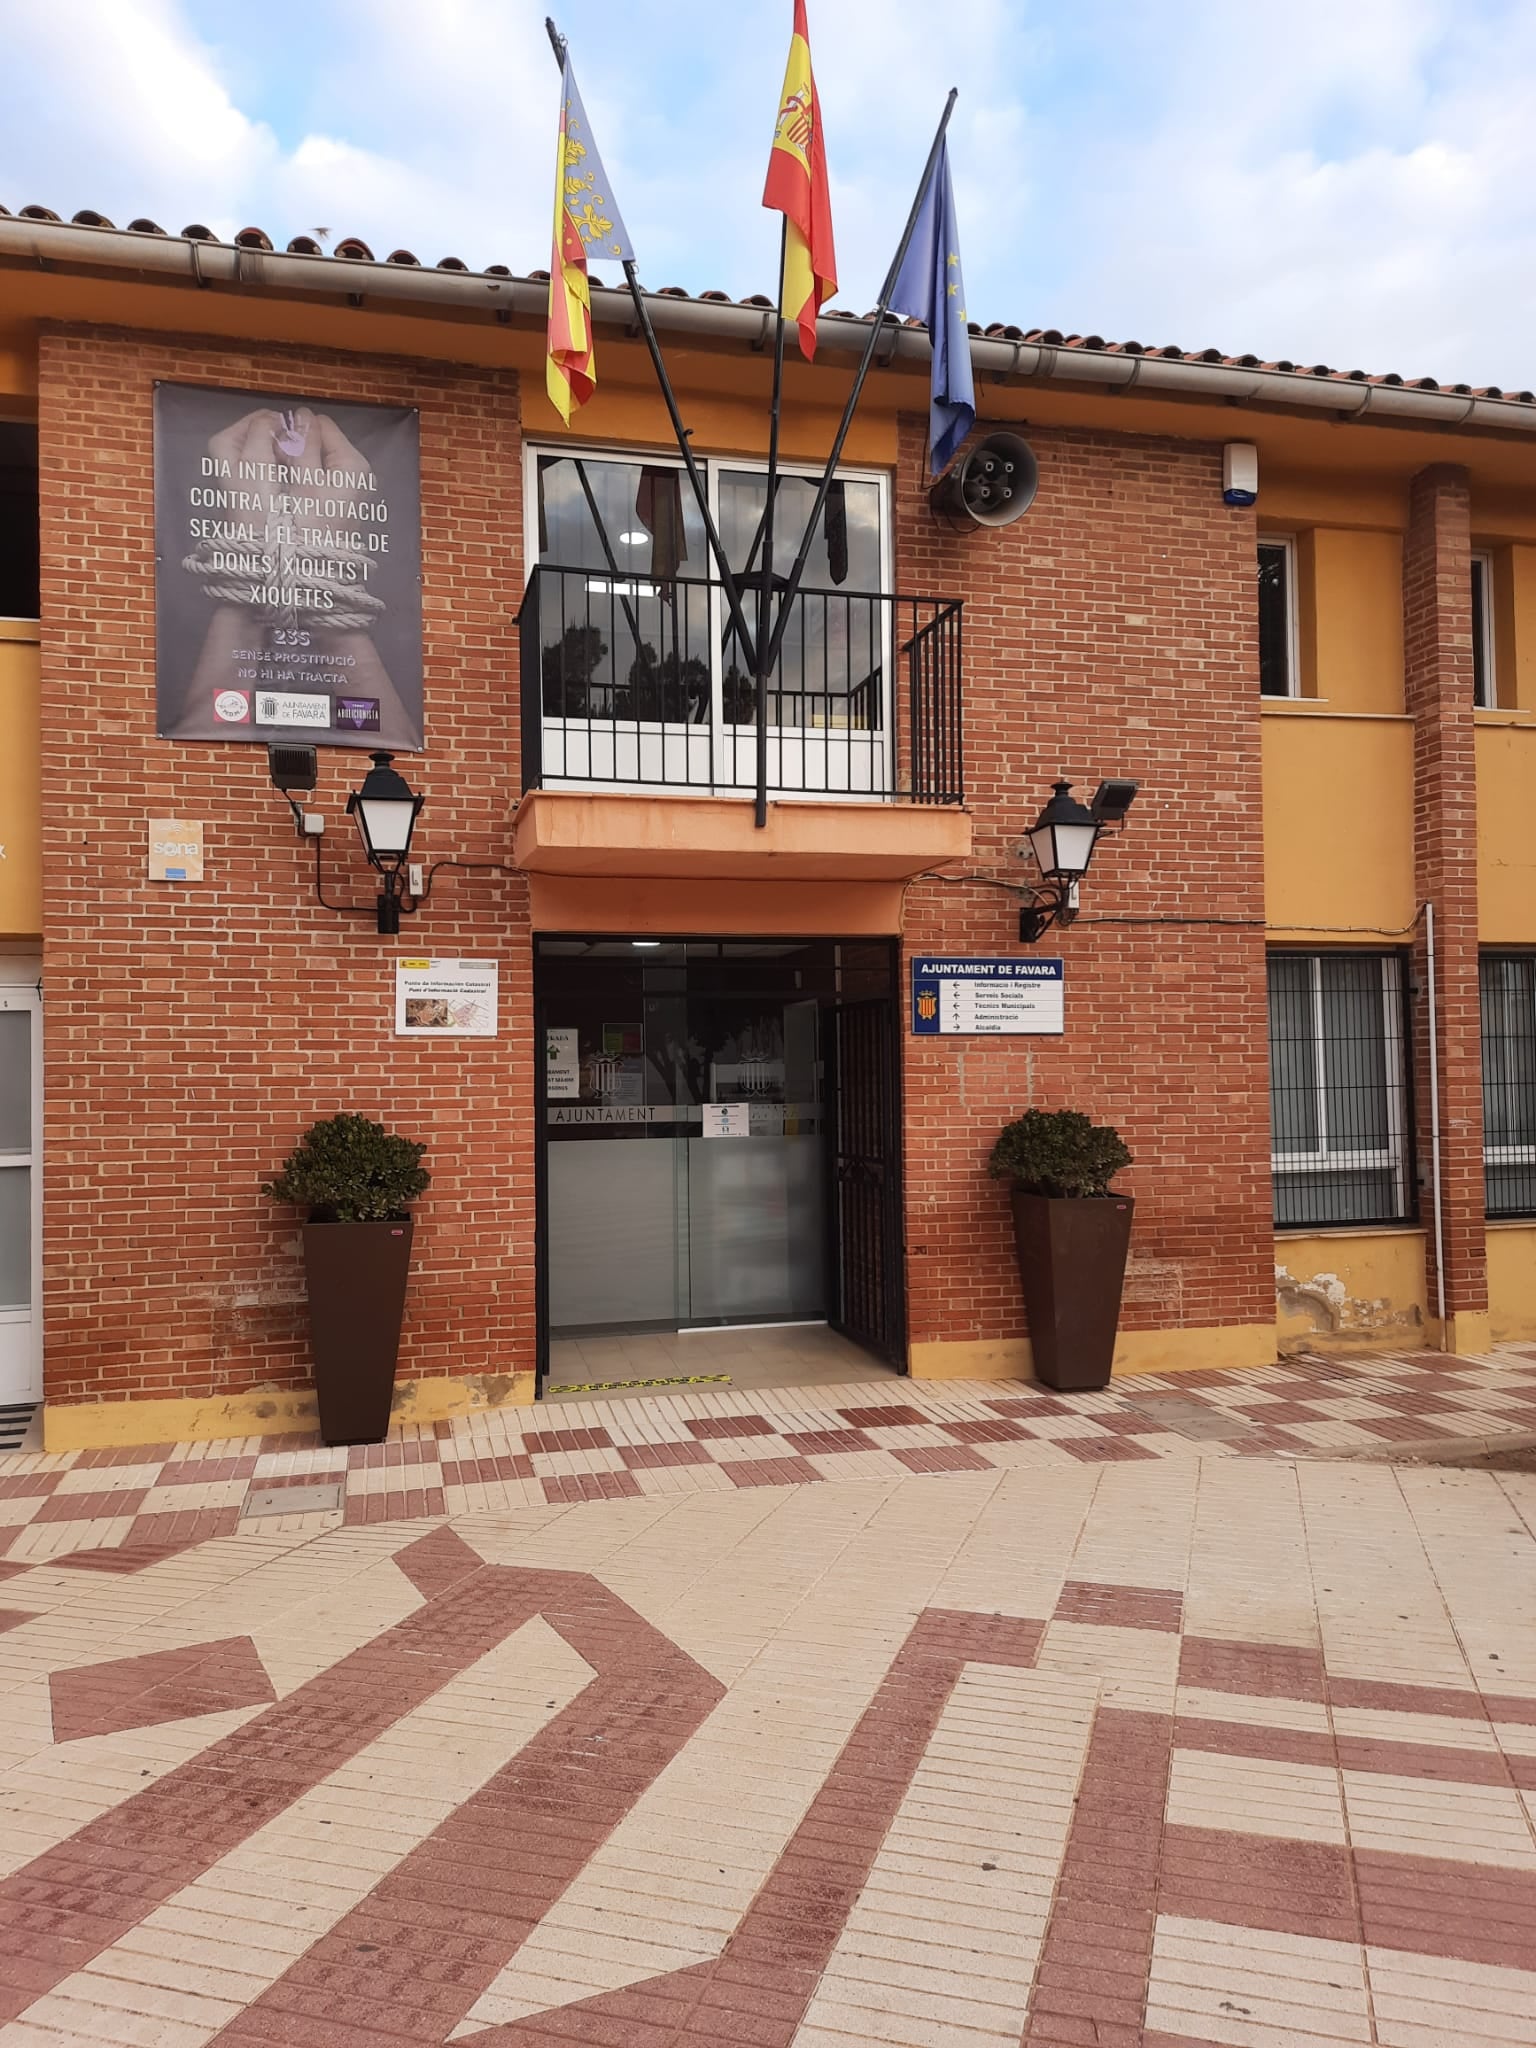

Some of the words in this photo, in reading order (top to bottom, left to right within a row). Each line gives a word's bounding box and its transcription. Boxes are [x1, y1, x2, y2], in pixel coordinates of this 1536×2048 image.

[201, 457, 232, 478] DIA
[239, 461, 377, 491] INTERNACIONAL
[190, 487, 263, 511] CONTRA
[269, 494, 388, 523] L'EXPLOTACIÓ
[190, 518, 257, 542] SEXUAL
[264, 524, 269, 543] I
[277, 526, 295, 545] EL
[301, 524, 362, 550] TRÀFIC
[368, 533, 389, 553] DE
[213, 551, 277, 577] DONES,
[284, 556, 357, 580] XIQUETS
[363, 563, 368, 581] I
[250, 584, 334, 609] XIQUETES
[231, 649, 271, 662] SENSE
[274, 652, 356, 667] PROSTITUCIÓ
[238, 667, 257, 679] NO
[260, 669, 273, 680] HI
[277, 669, 295, 681] HA
[299, 671, 348, 684] TRACTA
[282, 701, 327, 710] AJUNTAMENT
[292, 709, 326, 720] FAVARA
[921, 963, 996, 975] AJUNTAMENT
[998, 965, 1013, 975] DE
[1015, 965, 1056, 976] FAVARA
[1014, 981, 1041, 990] Registre
[1001, 1002, 1036, 1010] Municipals
[555, 1106, 656, 1123] AJUNTAMENT
